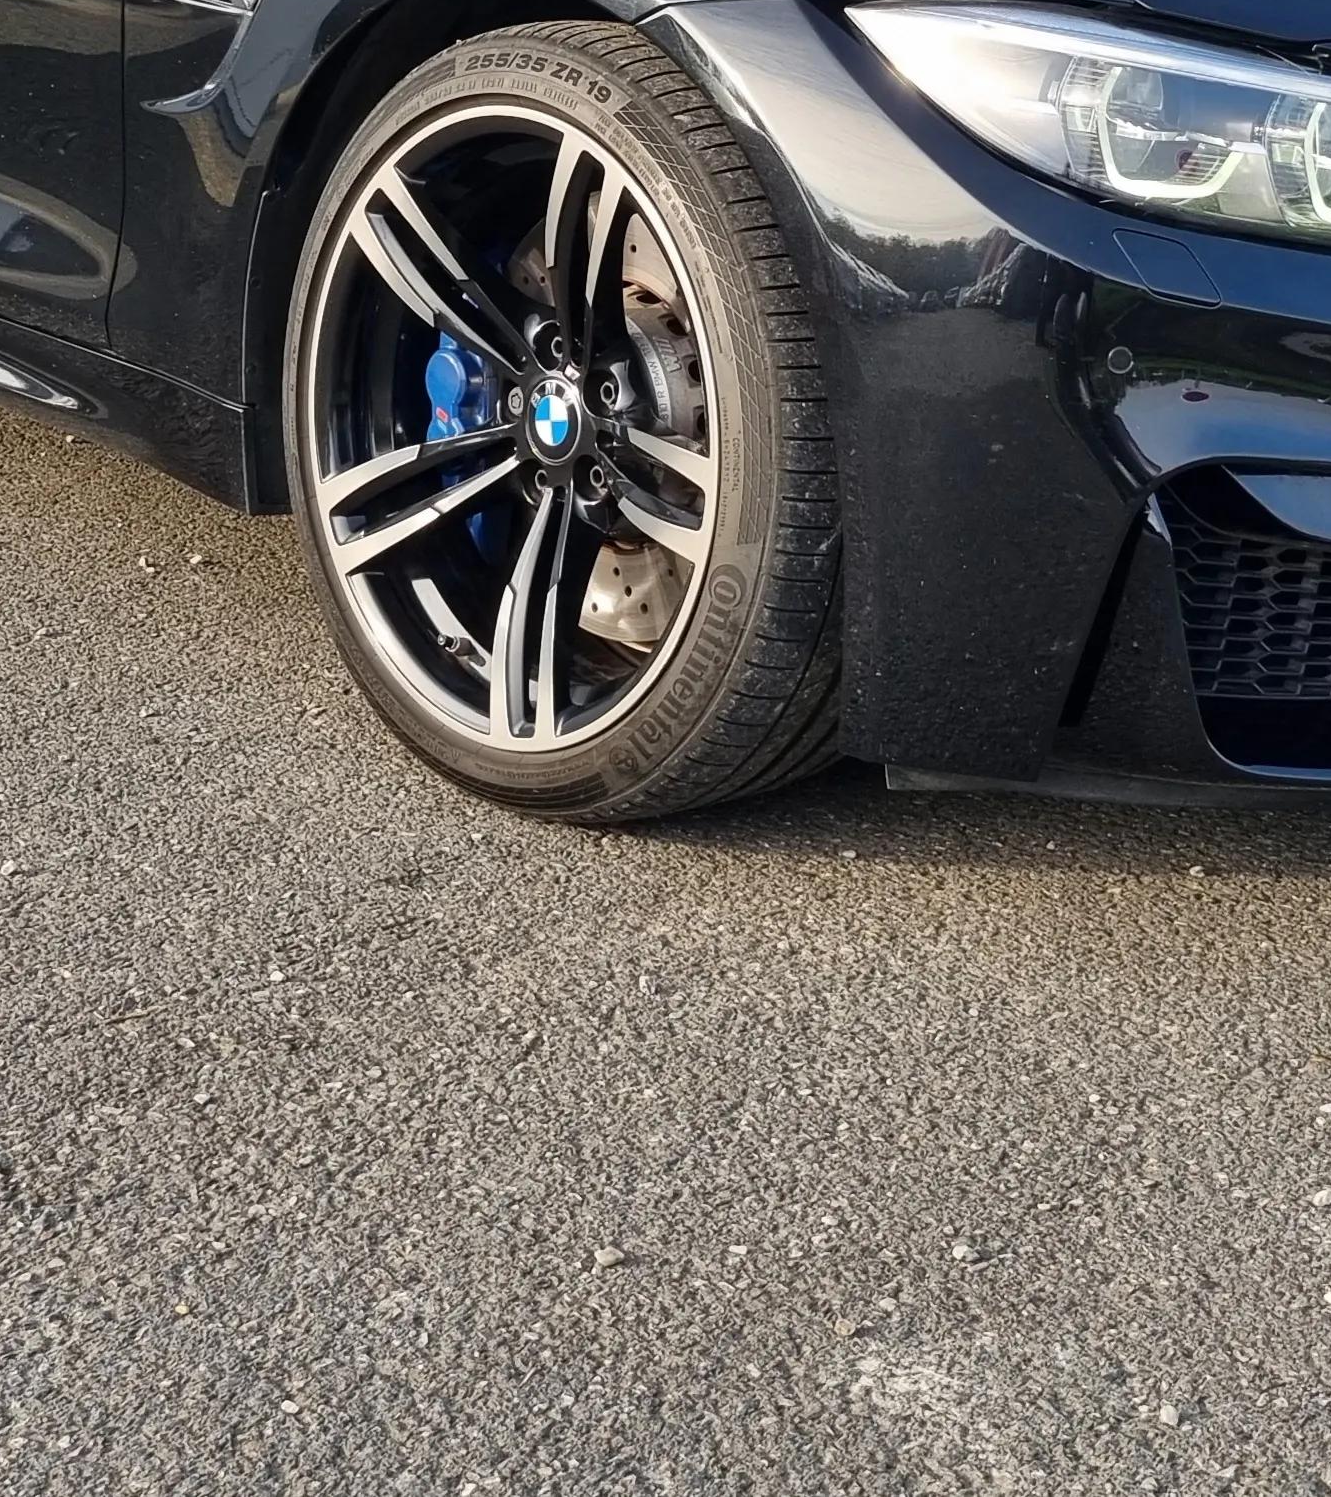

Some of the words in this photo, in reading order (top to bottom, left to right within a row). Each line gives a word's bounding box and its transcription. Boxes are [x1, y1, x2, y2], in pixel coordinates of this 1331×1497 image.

[464, 52, 548, 73] 255/35
[550, 61, 583, 87] ZR
[586, 79, 612, 104] 19
[627, 563, 747, 761] Continental
